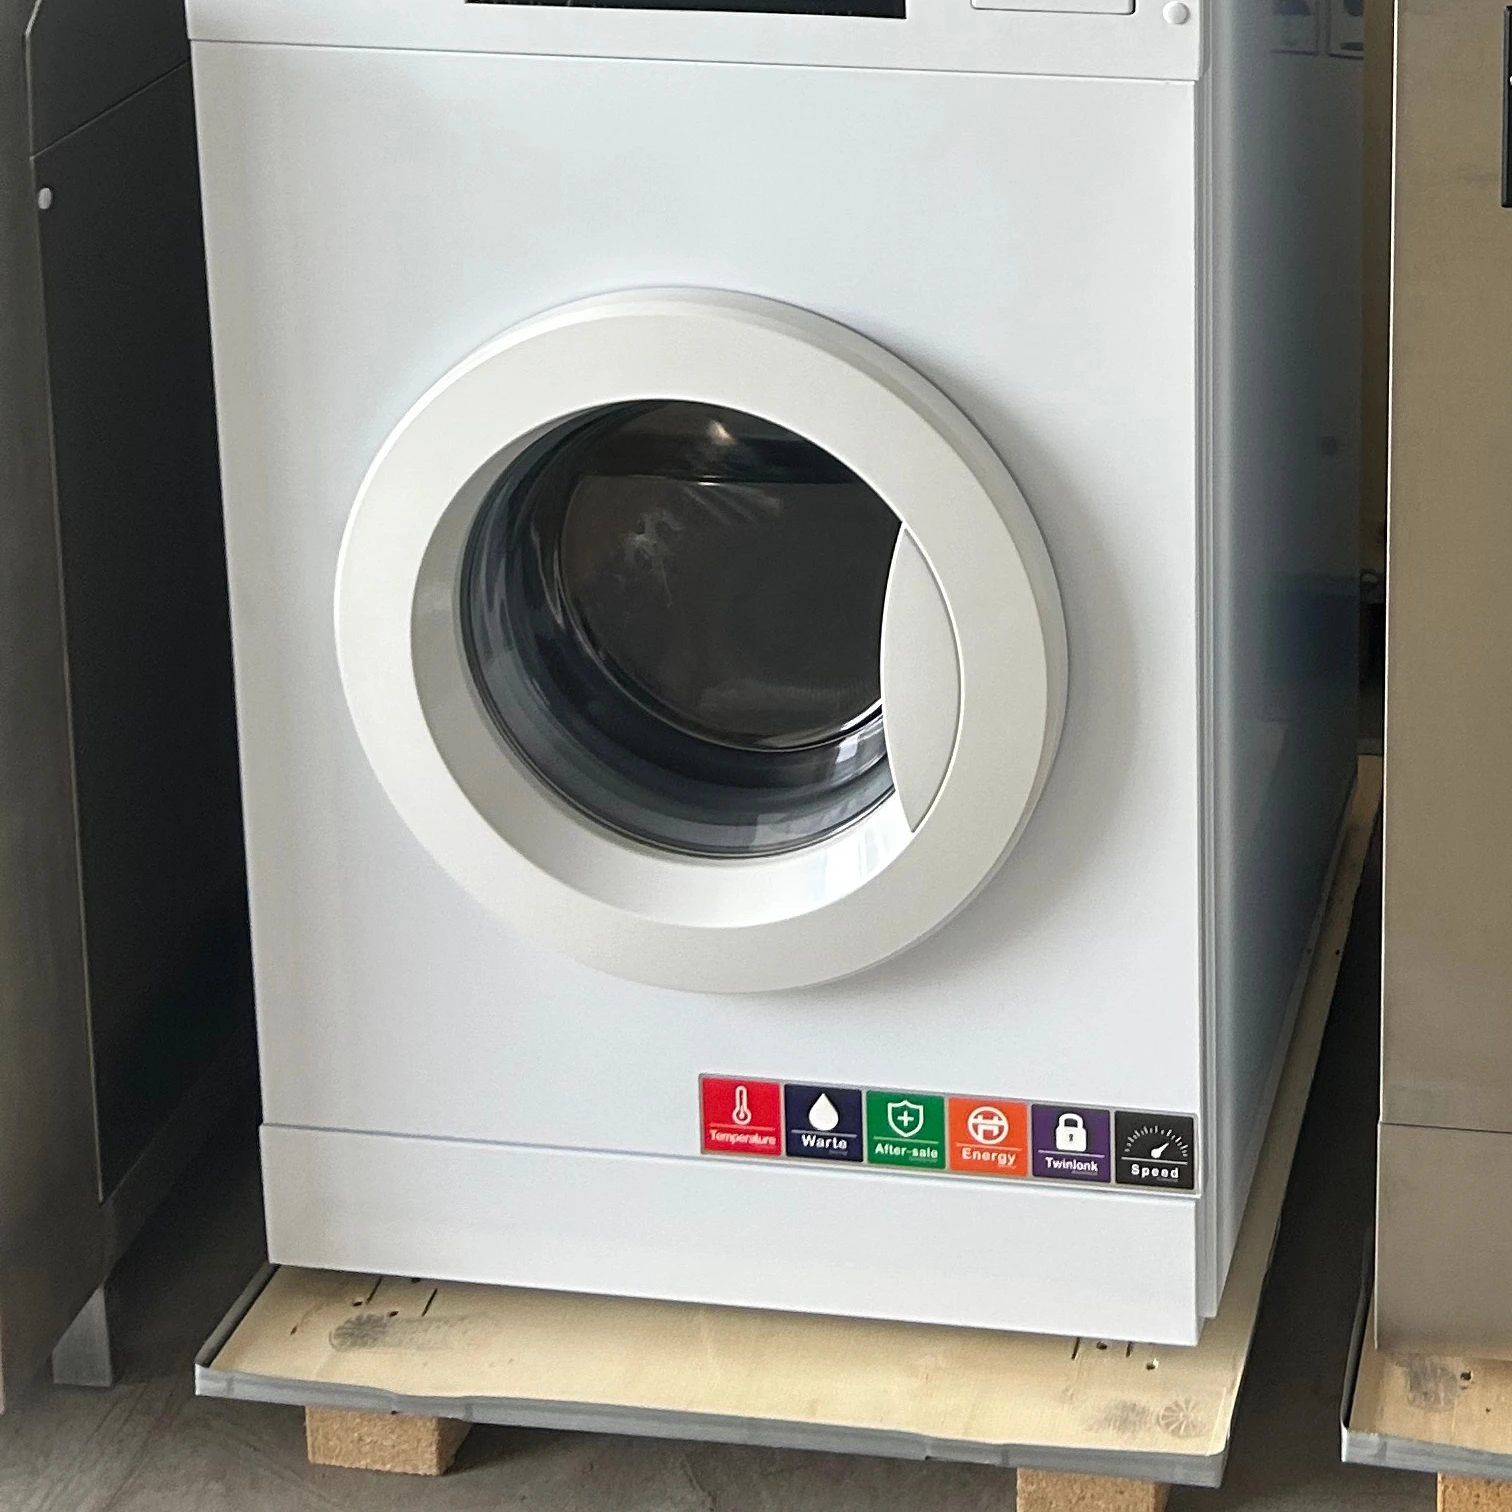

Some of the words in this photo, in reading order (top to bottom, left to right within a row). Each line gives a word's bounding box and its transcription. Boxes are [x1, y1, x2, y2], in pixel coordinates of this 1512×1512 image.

[710, 1129, 777, 1147] Temperature
[875, 1143, 938, 1159] After-sale
[962, 1147, 1017, 1167] Energy
[1131, 1164, 1179, 1179] Speed
